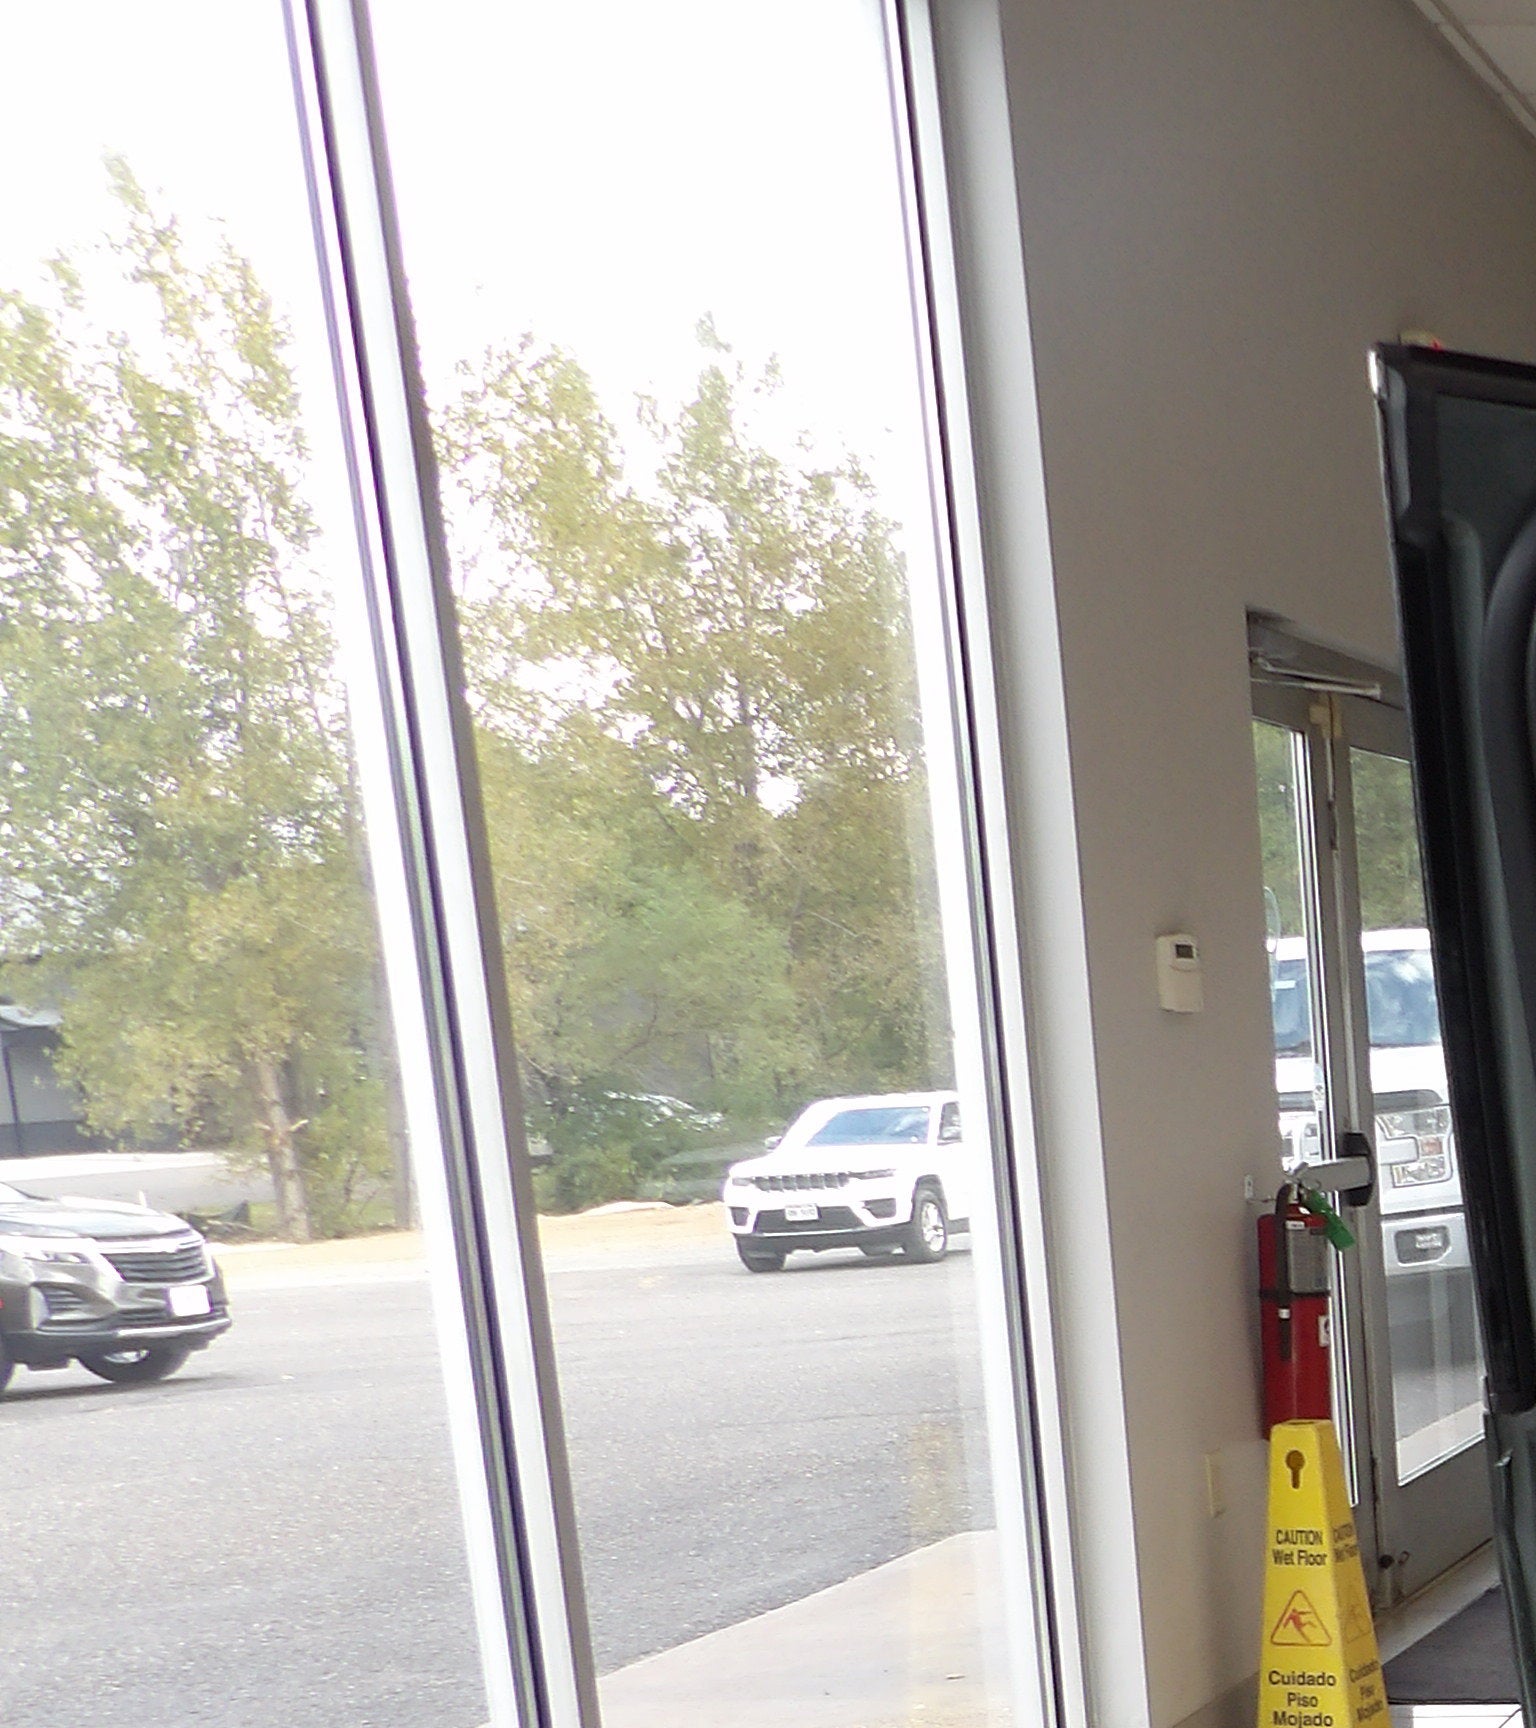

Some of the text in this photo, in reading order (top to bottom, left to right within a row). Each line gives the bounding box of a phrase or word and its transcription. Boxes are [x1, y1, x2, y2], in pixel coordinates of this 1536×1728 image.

[1276, 1529, 1324, 1545] CAUTION
[1272, 1549, 1295, 1565] Wet
[1297, 1549, 1328, 1566] Floor
[1268, 1670, 1336, 1686] Cuidado
[1287, 1692, 1318, 1707] Piso
